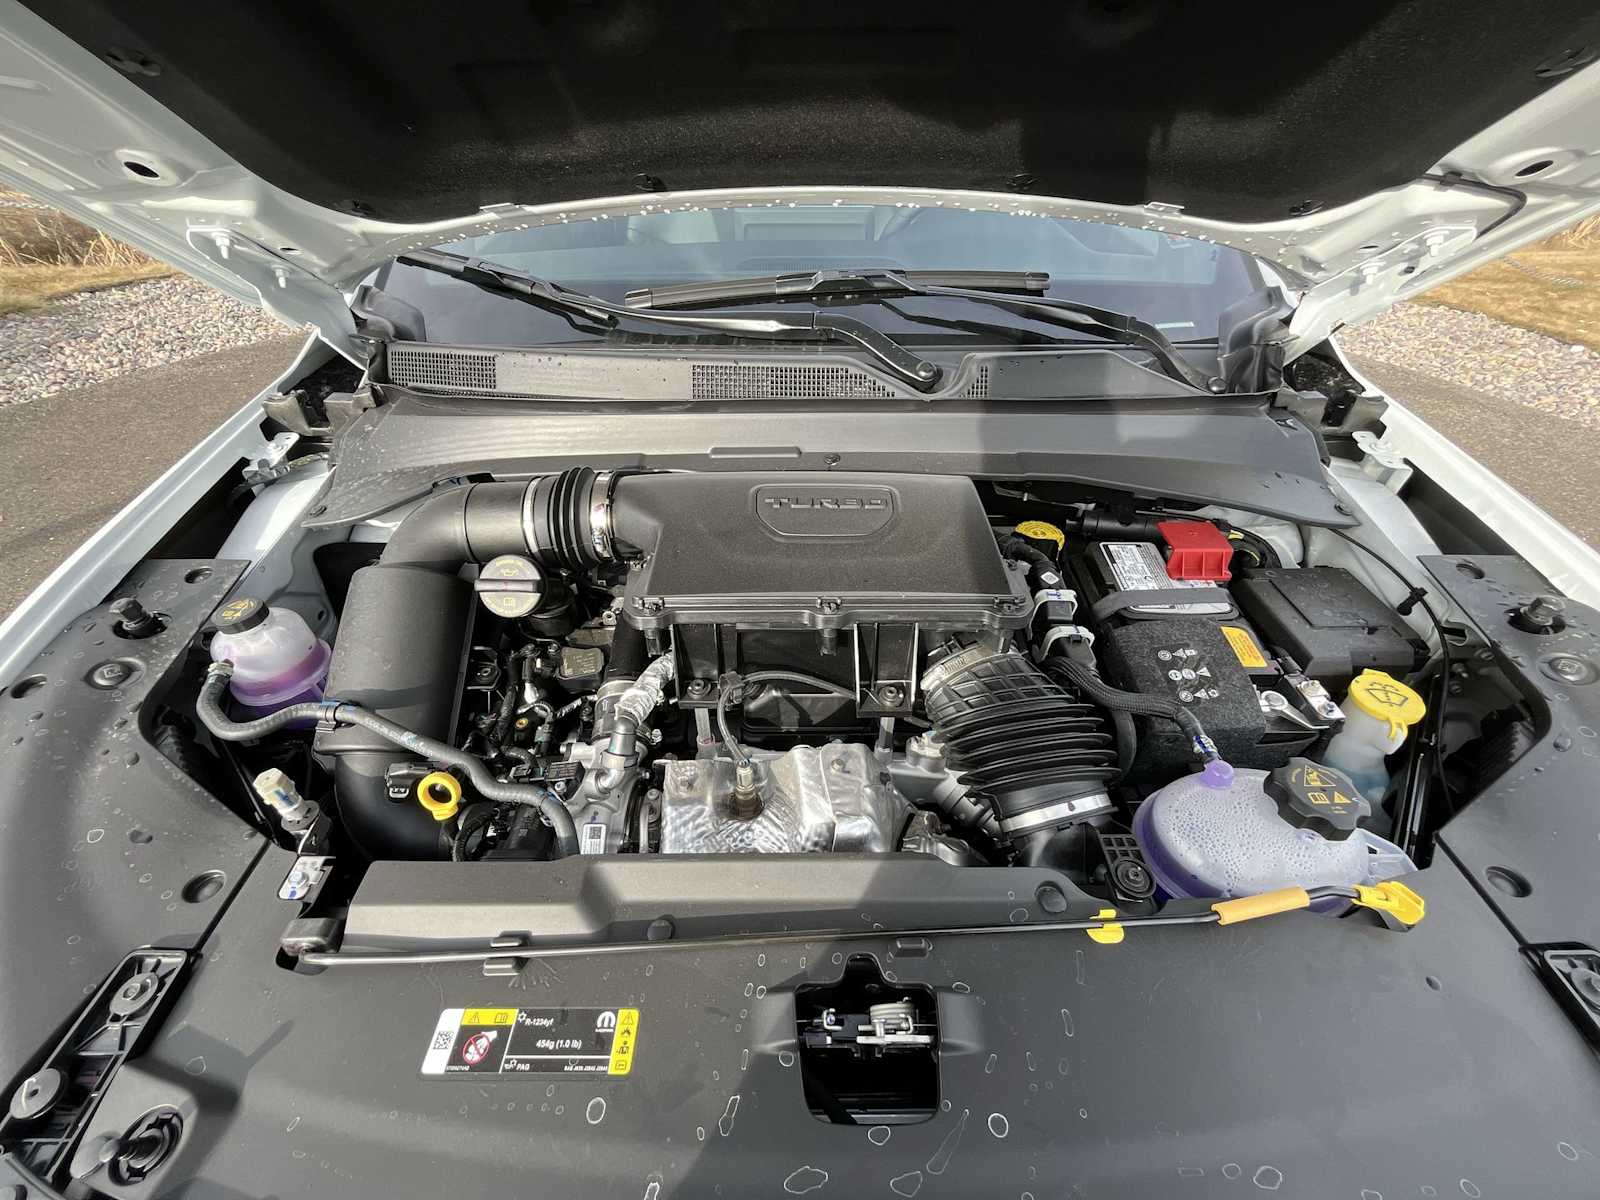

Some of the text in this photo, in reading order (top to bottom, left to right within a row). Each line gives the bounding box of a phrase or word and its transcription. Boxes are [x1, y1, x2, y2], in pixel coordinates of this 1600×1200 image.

[763, 497, 888, 510] TURBO
[525, 1017, 554, 1028] R-1234yf
[535, 1039, 583, 1050] 454g (1.0 lb)
[516, 1063, 530, 1071] PAG
